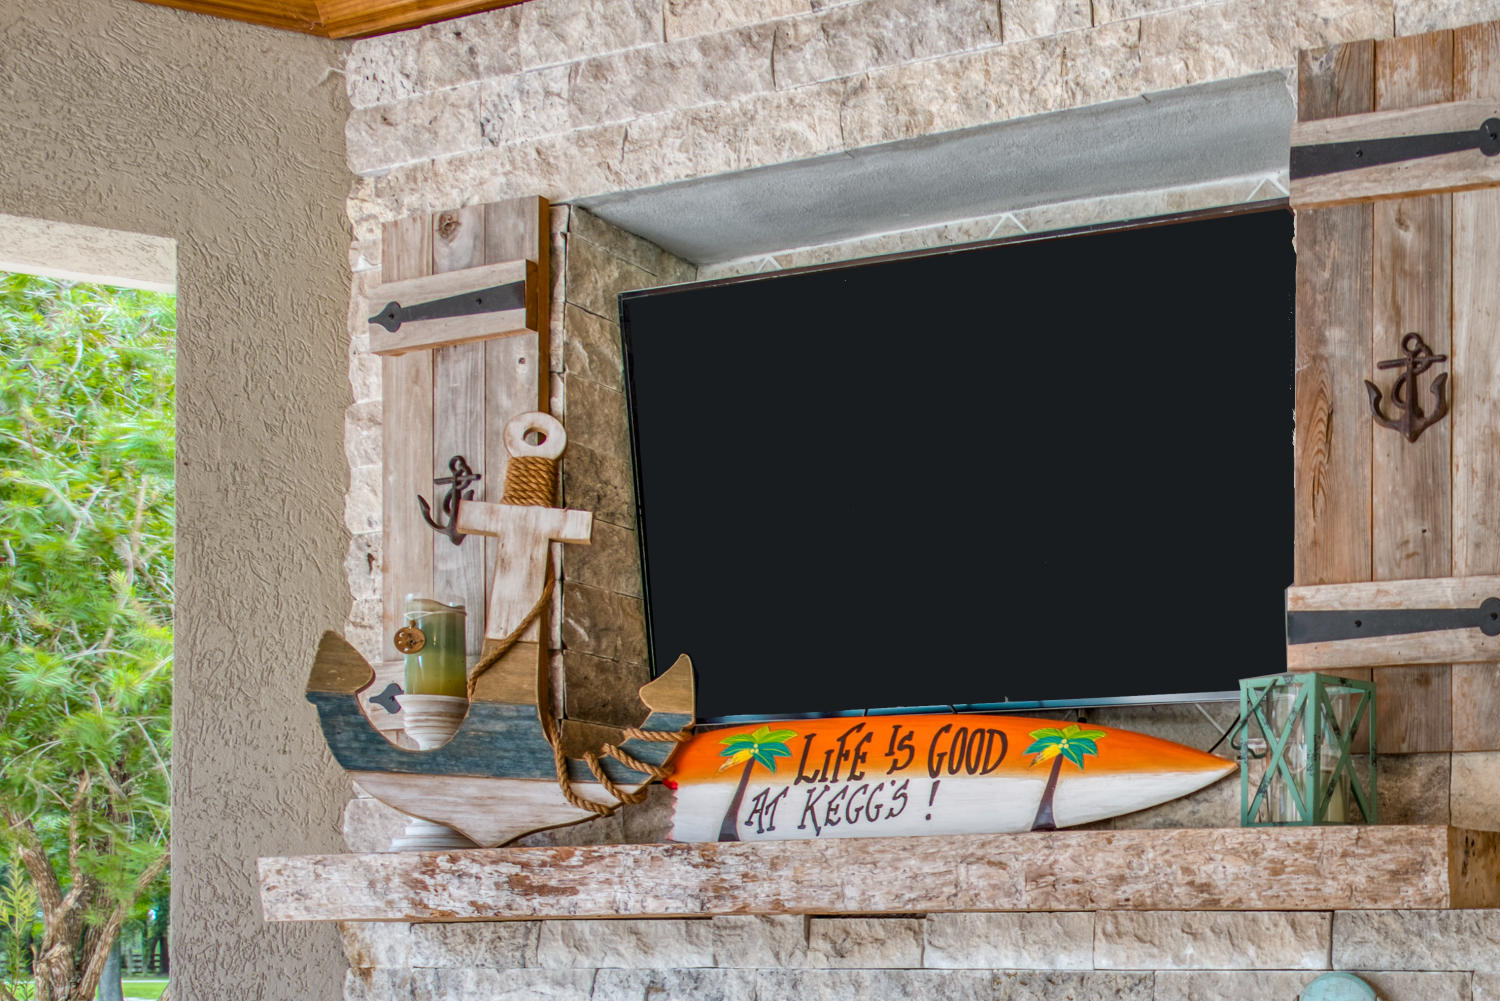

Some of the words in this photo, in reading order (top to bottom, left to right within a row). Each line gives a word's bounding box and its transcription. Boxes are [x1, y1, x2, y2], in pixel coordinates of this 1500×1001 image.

[795, 722, 873, 784] LIFE
[885, 724, 915, 774] IS
[927, 722, 1009, 777] GOOD
[744, 787, 789, 834] AT
